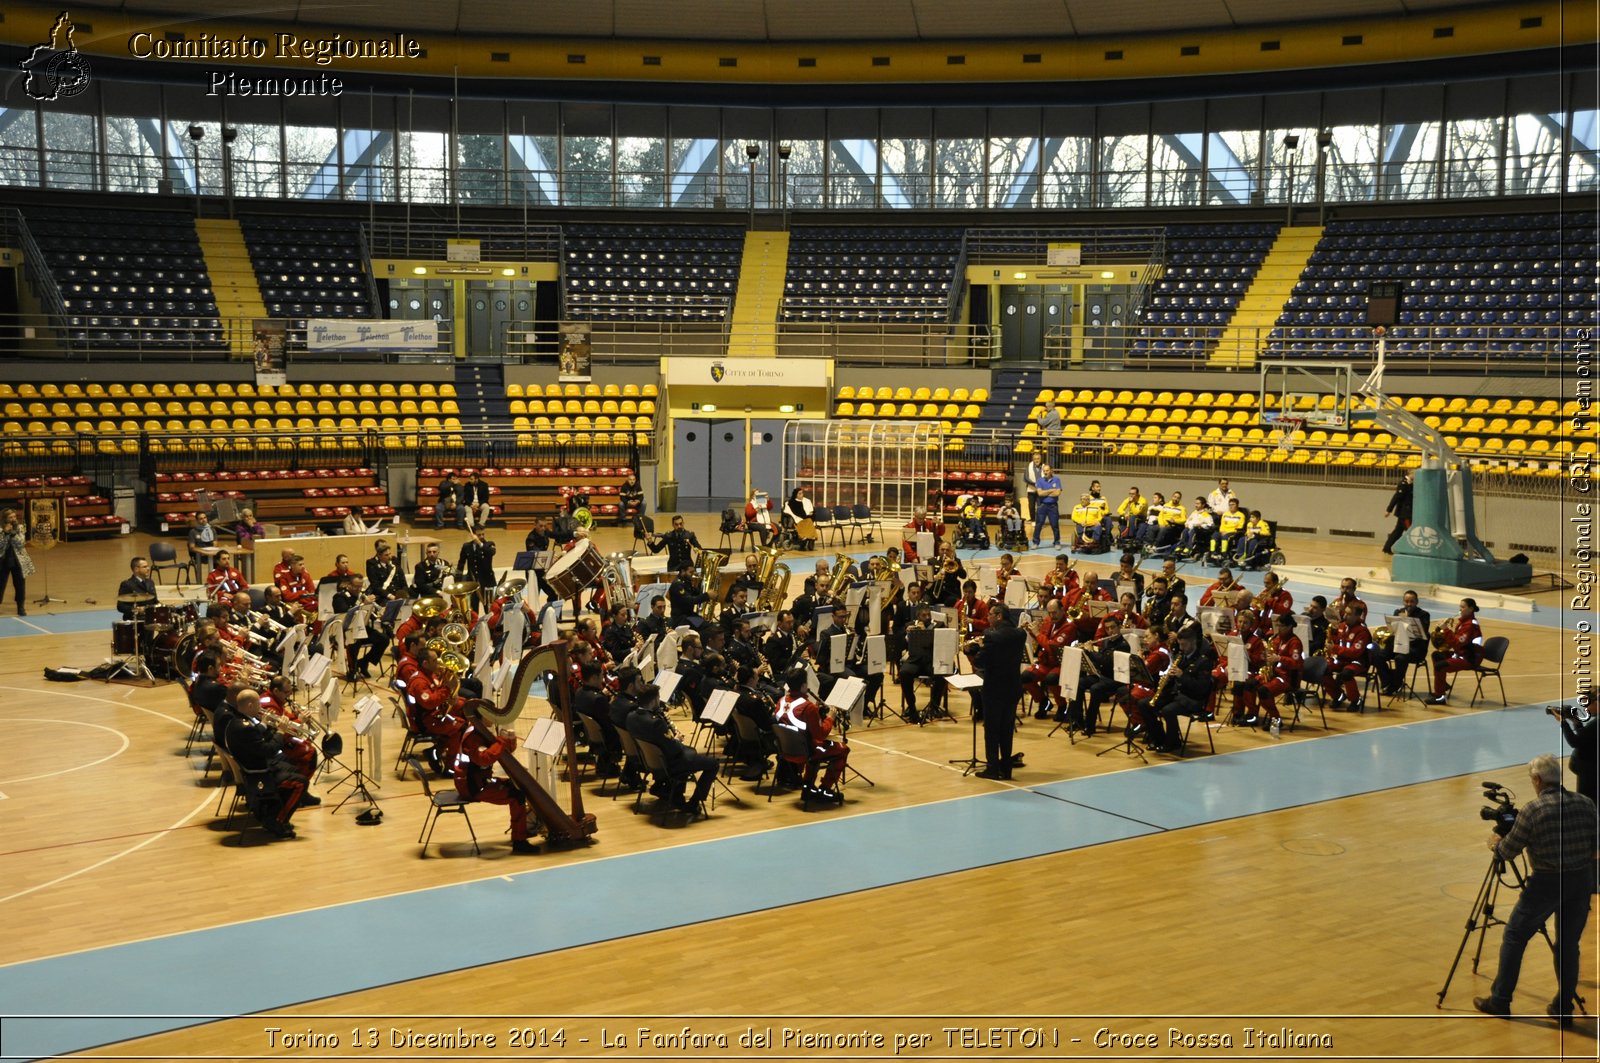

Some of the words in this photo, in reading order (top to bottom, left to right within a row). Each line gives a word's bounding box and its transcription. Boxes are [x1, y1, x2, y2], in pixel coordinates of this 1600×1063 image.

[313, 326, 346, 343] Telethon
[357, 326, 390, 343] Telethon
[400, 326, 433, 343] Telethon
